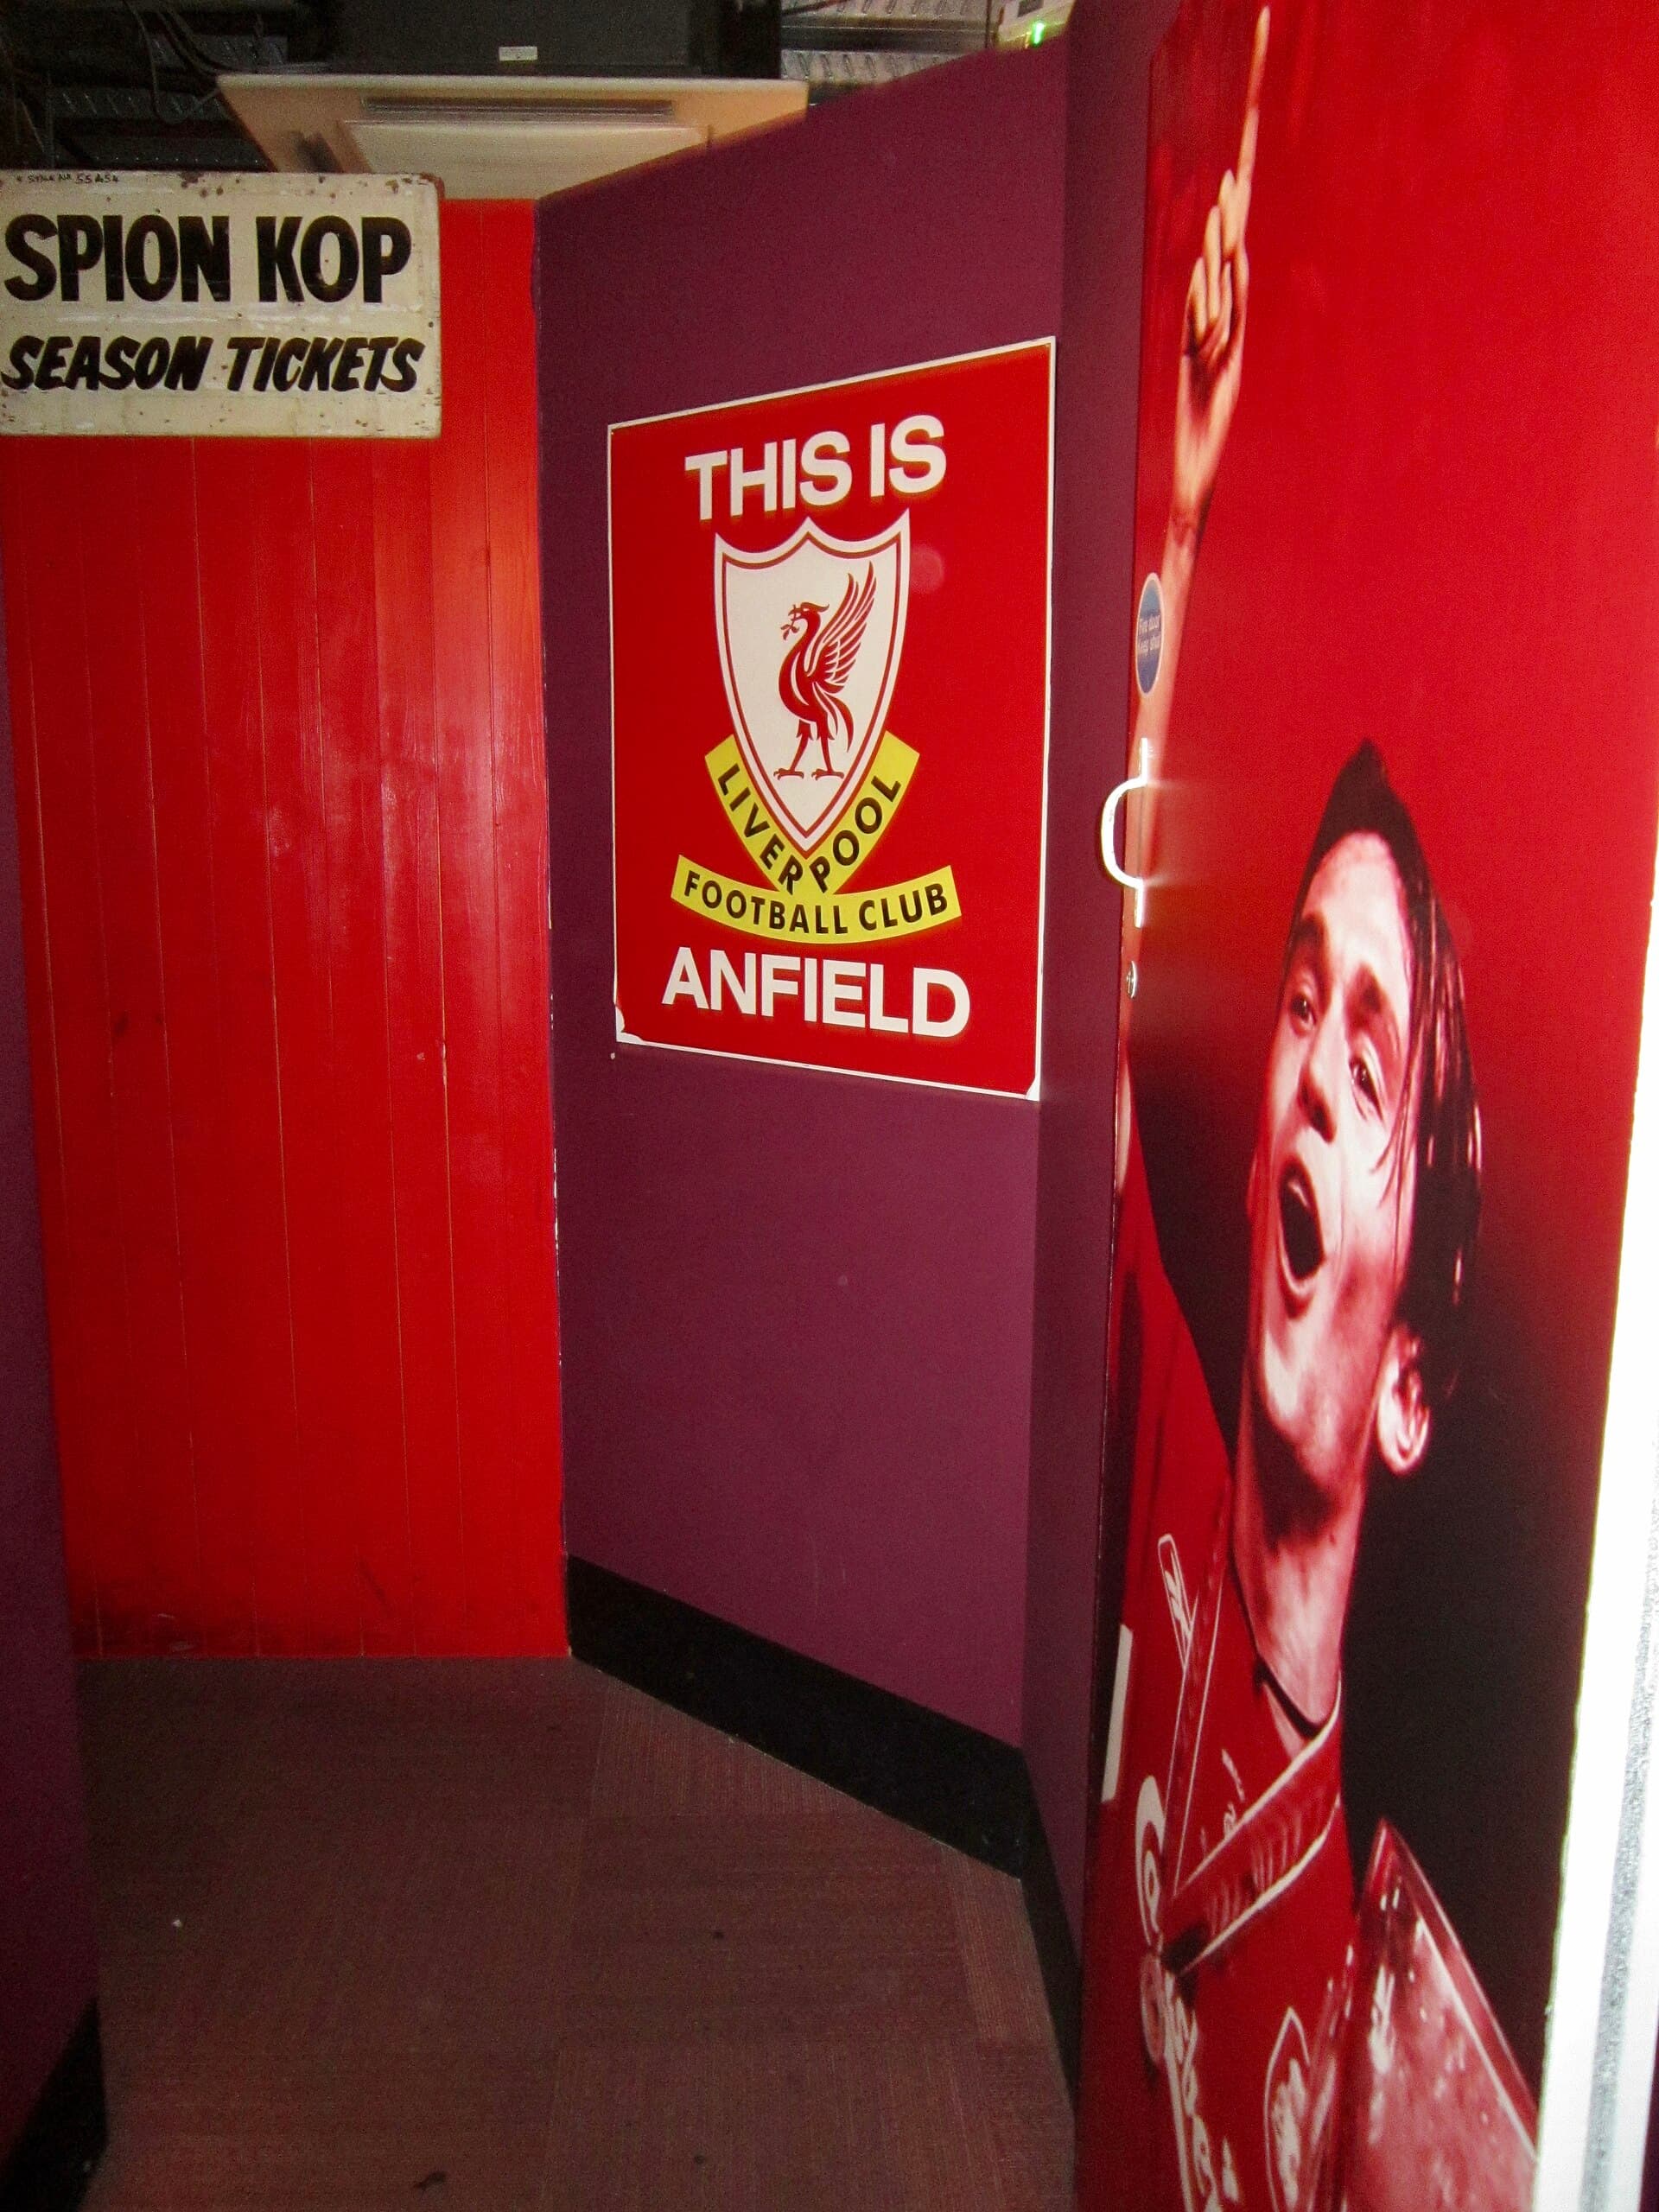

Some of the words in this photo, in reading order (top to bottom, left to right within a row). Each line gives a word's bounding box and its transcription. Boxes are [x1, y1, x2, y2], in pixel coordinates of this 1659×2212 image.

[3, 213, 232, 302] SPION
[255, 215, 412, 303] KOP
[0, 334, 214, 391] SEASON
[226, 335, 426, 393] TICKETS
[684, 430, 854, 521] THIS
[870, 414, 948, 499] IS
[716, 762, 902, 895] LIVERPOOL
[683, 869, 849, 936] FOOTBALL
[858, 882, 949, 932] CLUB
[661, 945, 972, 1039] ANFIELD
